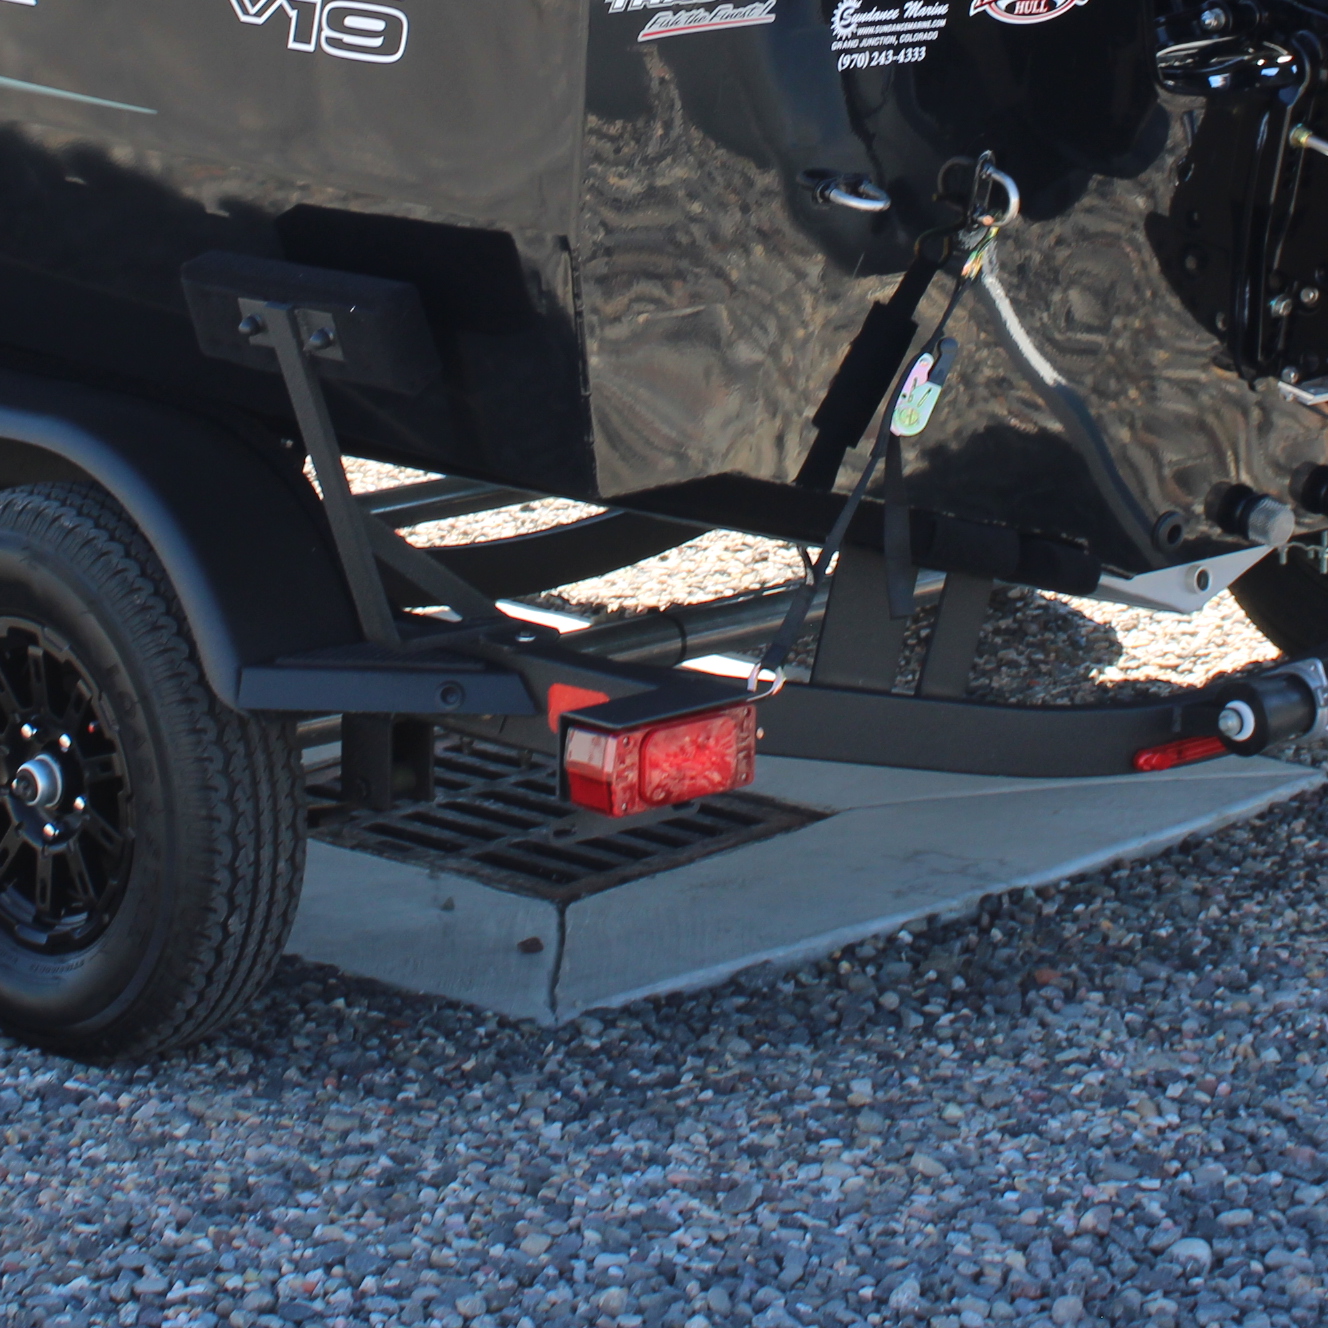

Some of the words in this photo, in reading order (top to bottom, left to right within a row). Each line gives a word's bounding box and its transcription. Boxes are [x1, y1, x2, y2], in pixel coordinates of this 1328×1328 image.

[839, 5, 900, 25] Sundance
[903, 0, 950, 19] Marine
[1014, 0, 1049, 14] HULL
[647, 11, 681, 30] Fish
[683, 9, 708, 25] the
[831, 39, 859, 51] GRAND
[859, 35, 898, 49] JUNCTION,
[899, 30, 939, 44] COLORADO
[837, 50, 869, 72] (970)
[870, 46, 927, 67] 243-4333
